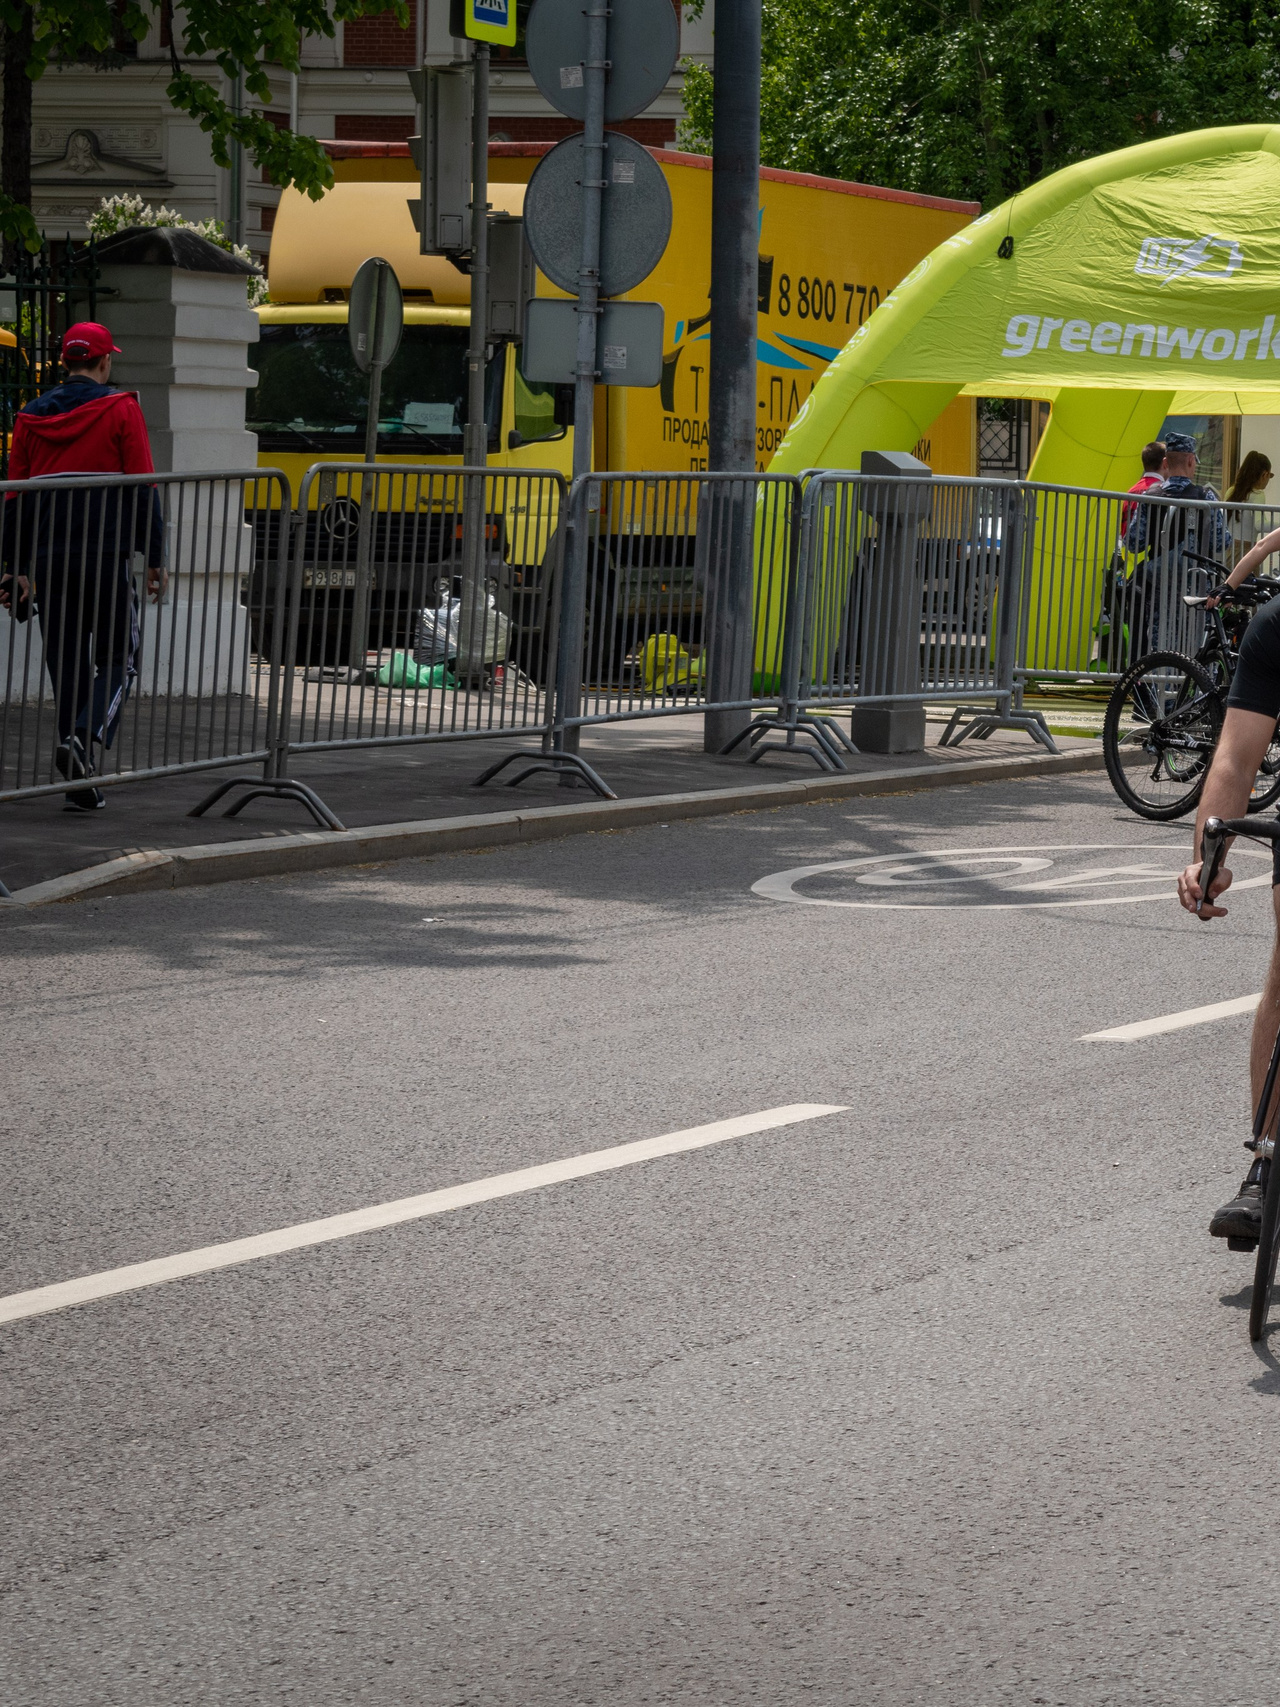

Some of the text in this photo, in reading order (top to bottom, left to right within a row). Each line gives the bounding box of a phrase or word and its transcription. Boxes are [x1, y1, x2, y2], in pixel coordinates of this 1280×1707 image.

[778, 273, 880, 327] 8 800 770
[663, 416, 709, 450] ПРОДА
[1120, 664, 1146, 692] MAXXIS
